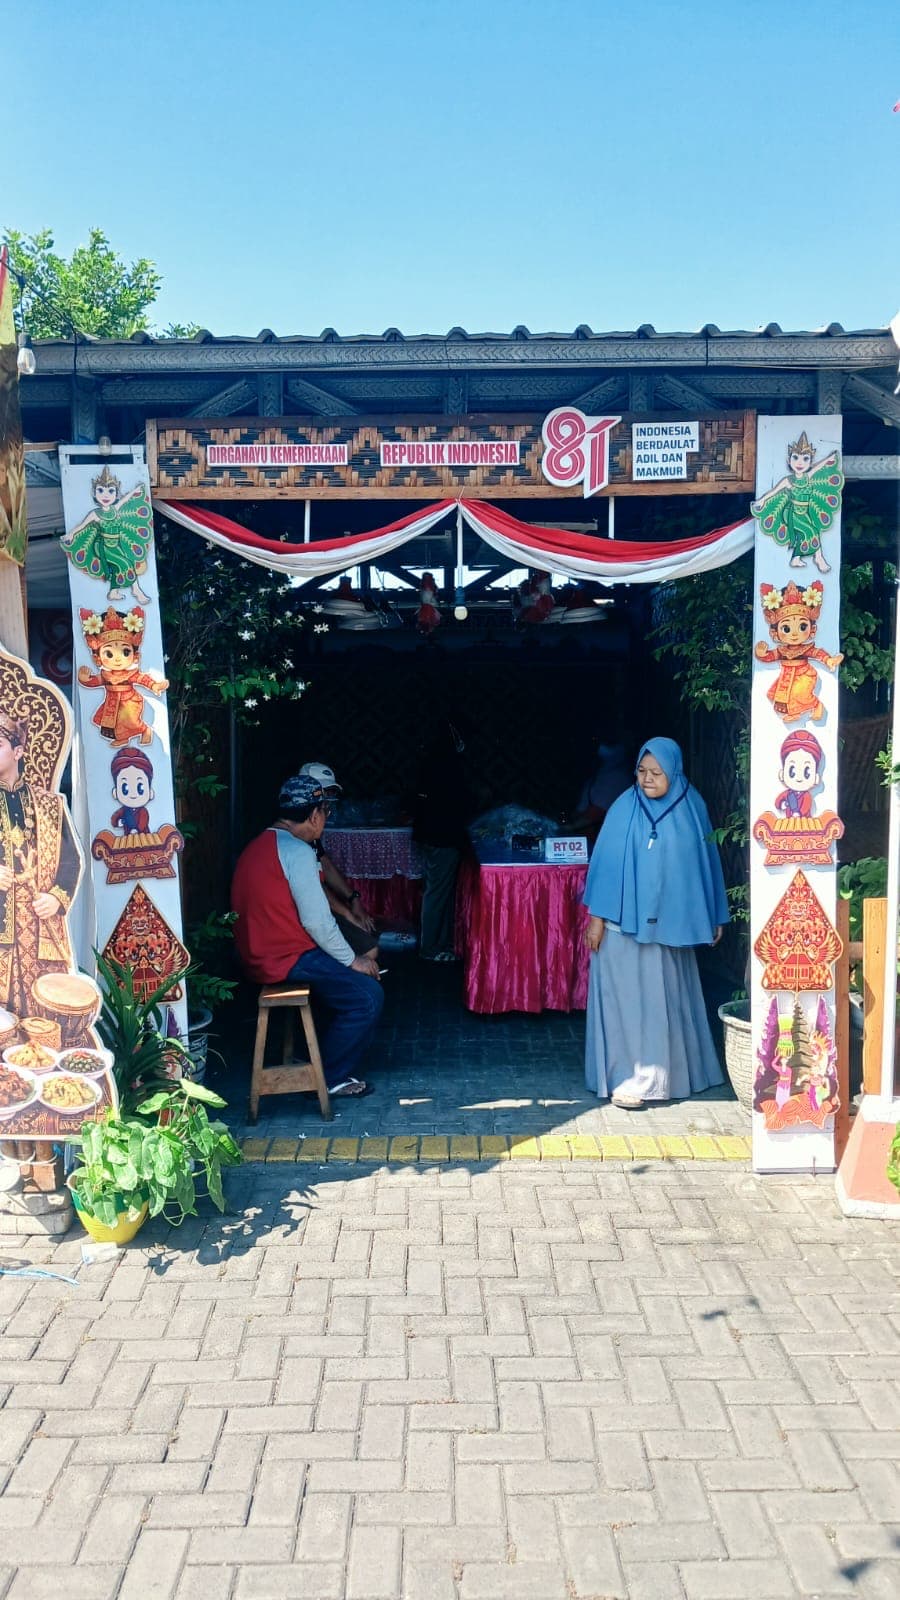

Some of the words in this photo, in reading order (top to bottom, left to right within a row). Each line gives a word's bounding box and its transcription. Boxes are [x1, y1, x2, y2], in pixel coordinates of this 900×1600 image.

[636, 425, 691, 437] INDONESIA
[636, 439, 696, 450] BERDAULAT
[209, 446, 268, 464] DIRGAHAYU
[270, 445, 346, 463] KEMERDEKAAN
[383, 444, 445, 464] REPUBLIK
[447, 443, 518, 464] INDONESIA
[546, 411, 617, 491] 81
[636, 452, 659, 464] ADIL
[661, 452, 683, 463] DAN
[636, 466, 683, 477] MAKMUR
[553, 842, 567, 852] RT
[569, 841, 582, 851] 02
